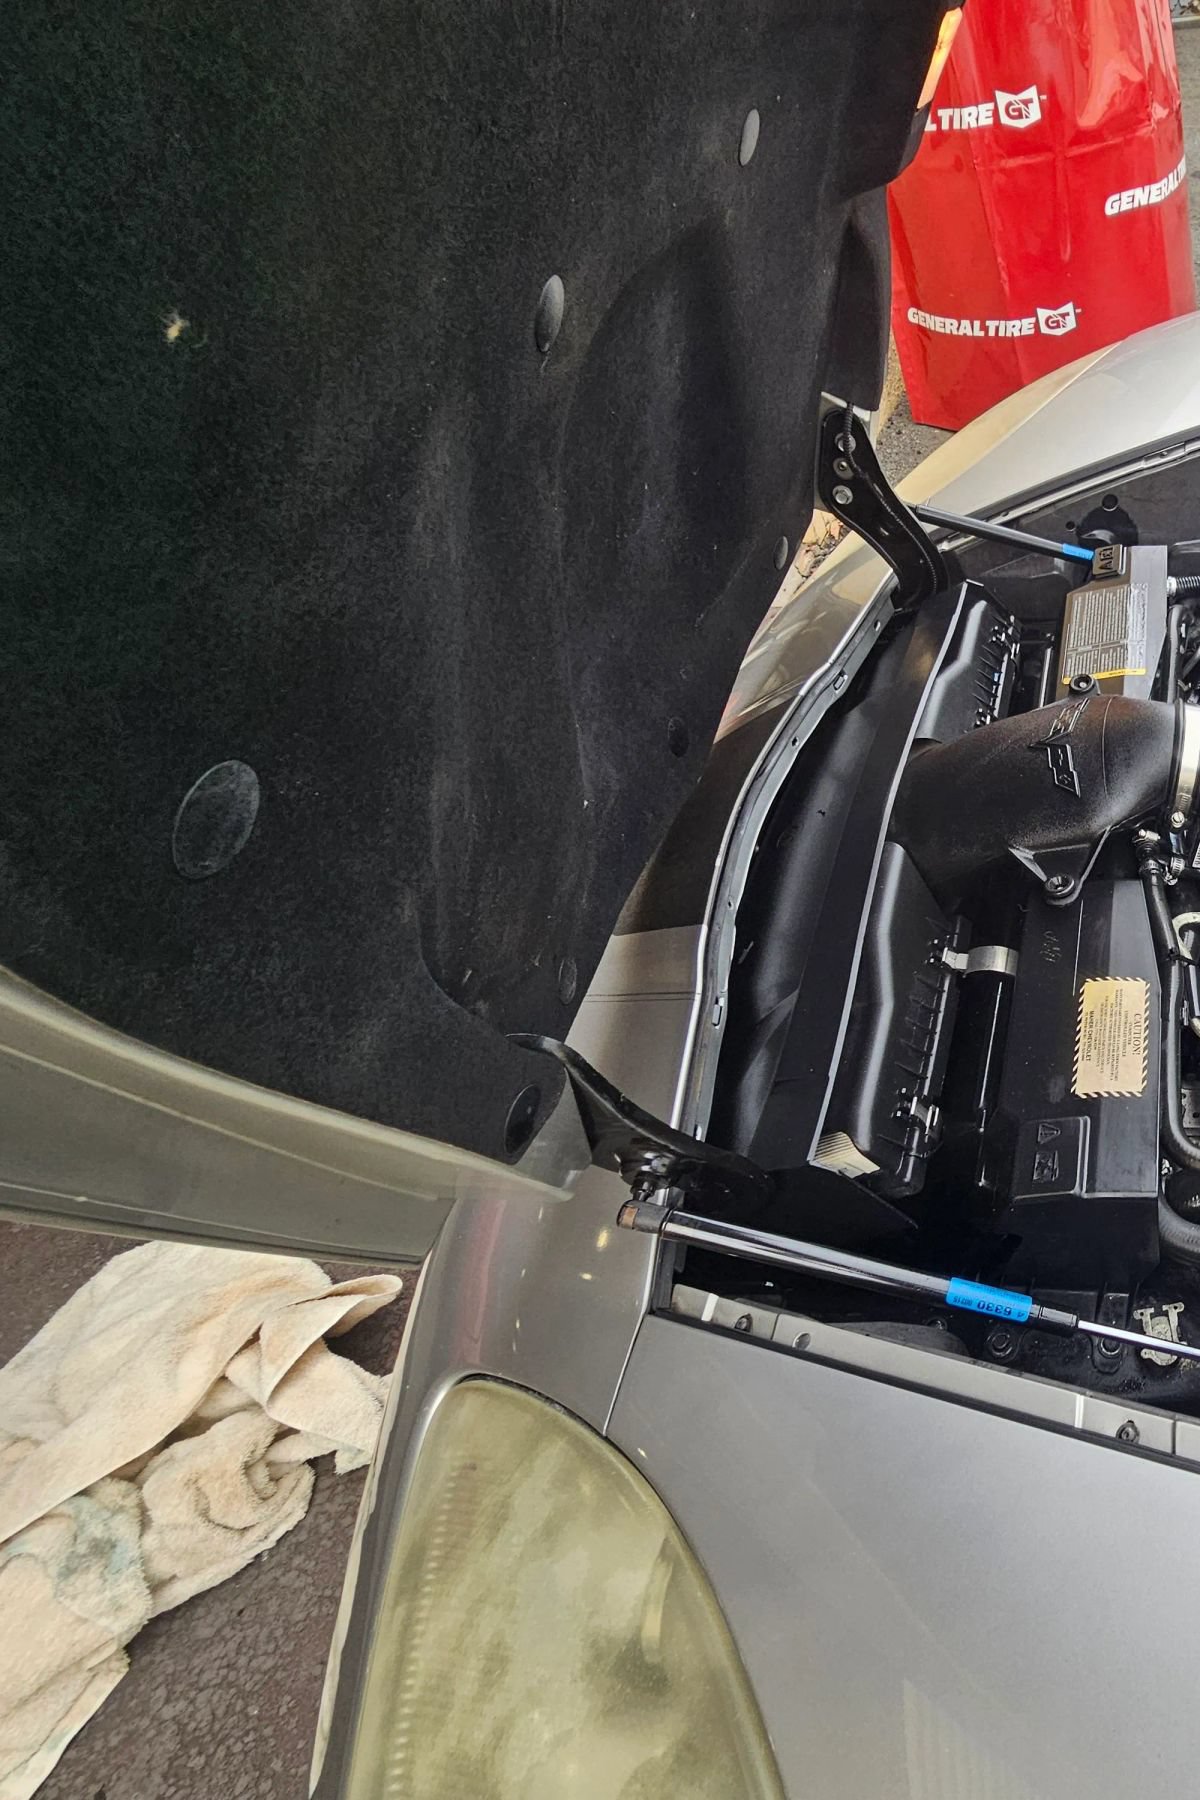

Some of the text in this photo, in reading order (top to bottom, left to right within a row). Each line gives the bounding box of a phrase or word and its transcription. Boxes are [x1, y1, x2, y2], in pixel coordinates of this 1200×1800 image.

[937, 102, 995, 131] TIRE
[1104, 167, 1180, 216] GENERAL
[907, 307, 985, 337] GENERAL
[985, 317, 1037, 337] TIRE
[1085, 1029, 1094, 1062] CHEVROLET
[1132, 1013, 1142, 1055] CAUTION!
